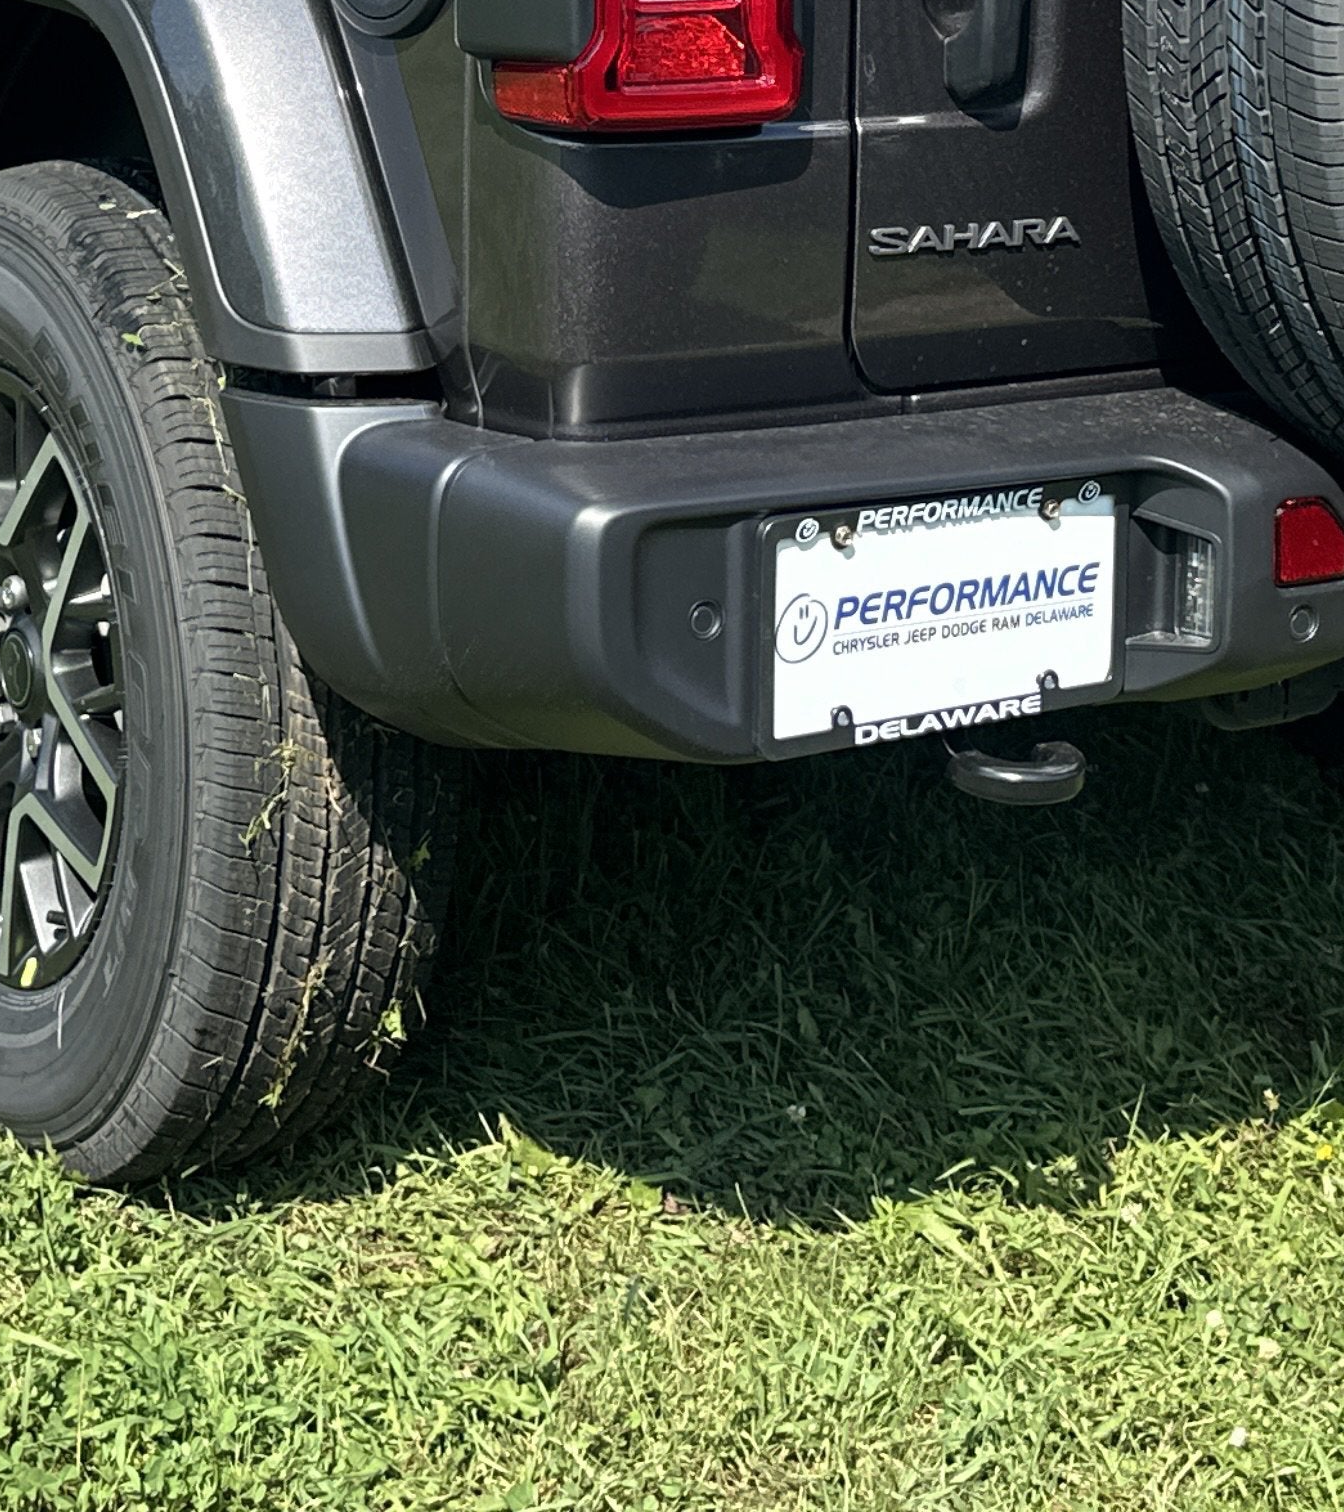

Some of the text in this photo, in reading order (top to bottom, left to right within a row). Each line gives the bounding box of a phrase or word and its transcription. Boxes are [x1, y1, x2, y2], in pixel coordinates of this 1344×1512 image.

[868, 216, 1082, 256] SAHARA
[856, 487, 1044, 533] PERFORMANCE
[833, 562, 1100, 630] PERFORMANCE
[833, 603, 1095, 656] CHRYSLER JEEP DODGE RAM DELAWARE
[854, 694, 1042, 746] DELAWARE
